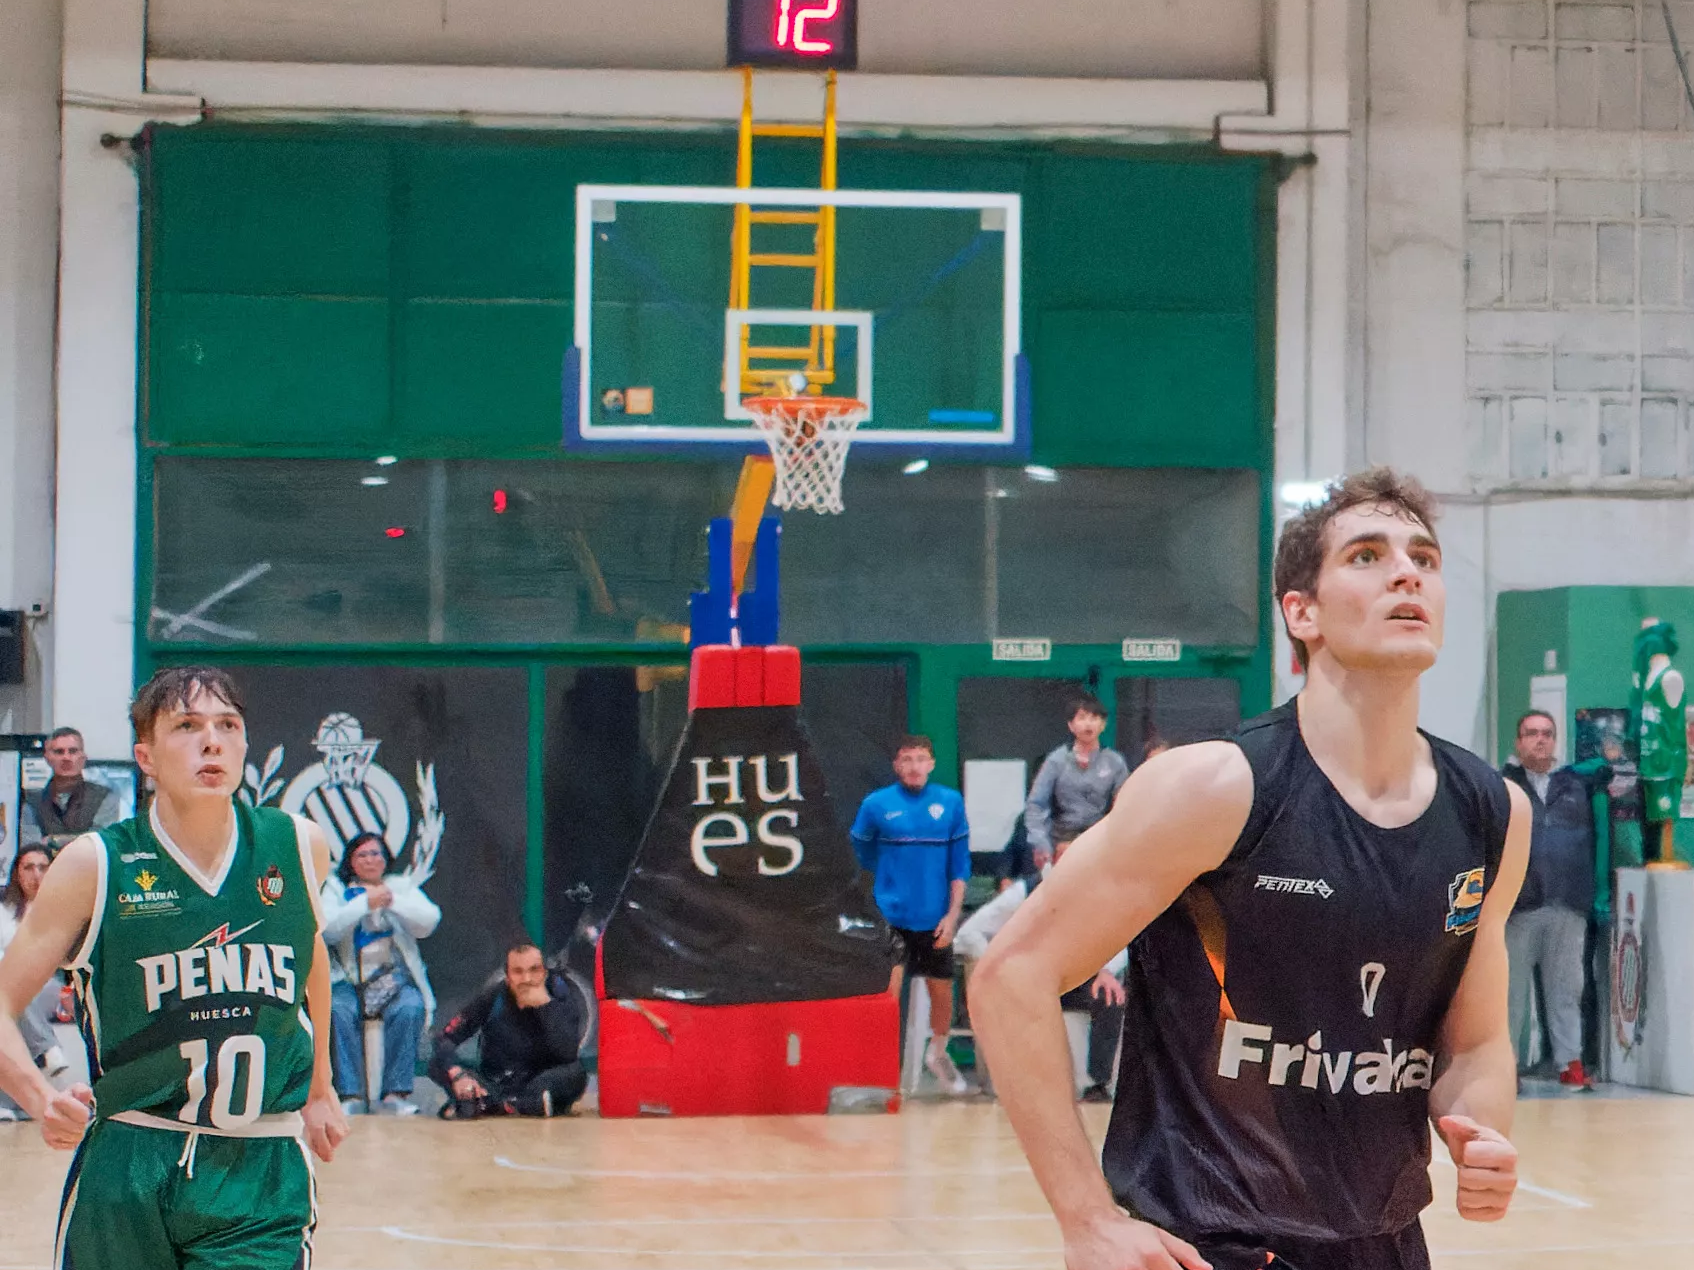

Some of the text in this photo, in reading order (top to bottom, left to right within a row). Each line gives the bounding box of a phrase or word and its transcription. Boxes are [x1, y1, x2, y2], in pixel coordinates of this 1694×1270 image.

[690, 807, 805, 878] es
[1253, 875, 1316, 895] PENTEX
[190, 1005, 252, 1022] HUESCA
[177, 1034, 267, 1131] 10
